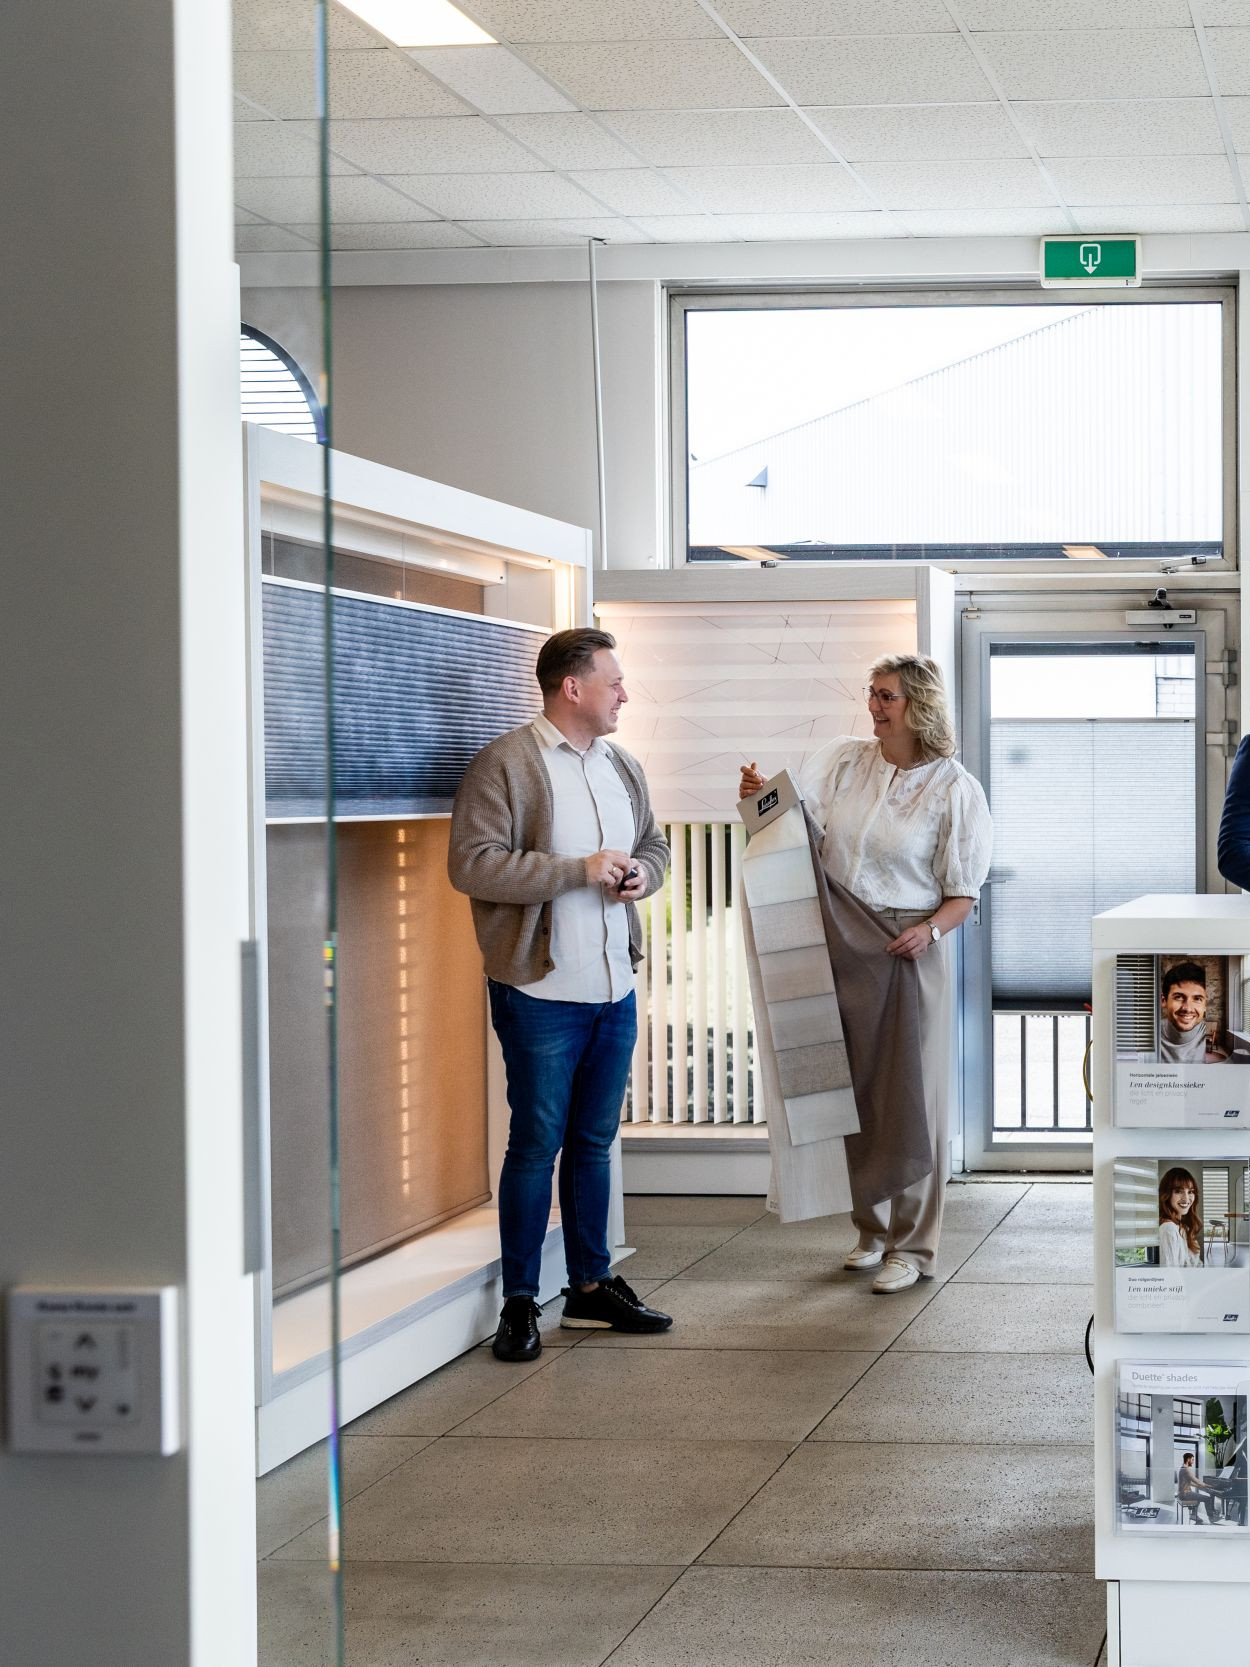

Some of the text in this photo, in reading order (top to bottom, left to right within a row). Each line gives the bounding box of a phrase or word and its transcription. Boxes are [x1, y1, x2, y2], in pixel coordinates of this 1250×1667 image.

[1144, 1081, 1206, 1089] designklassieker
[1143, 1285, 1168, 1293] unieke
[1168, 1285, 1183, 1294] stijl
[1132, 1371, 1198, 1382] Duette shades
